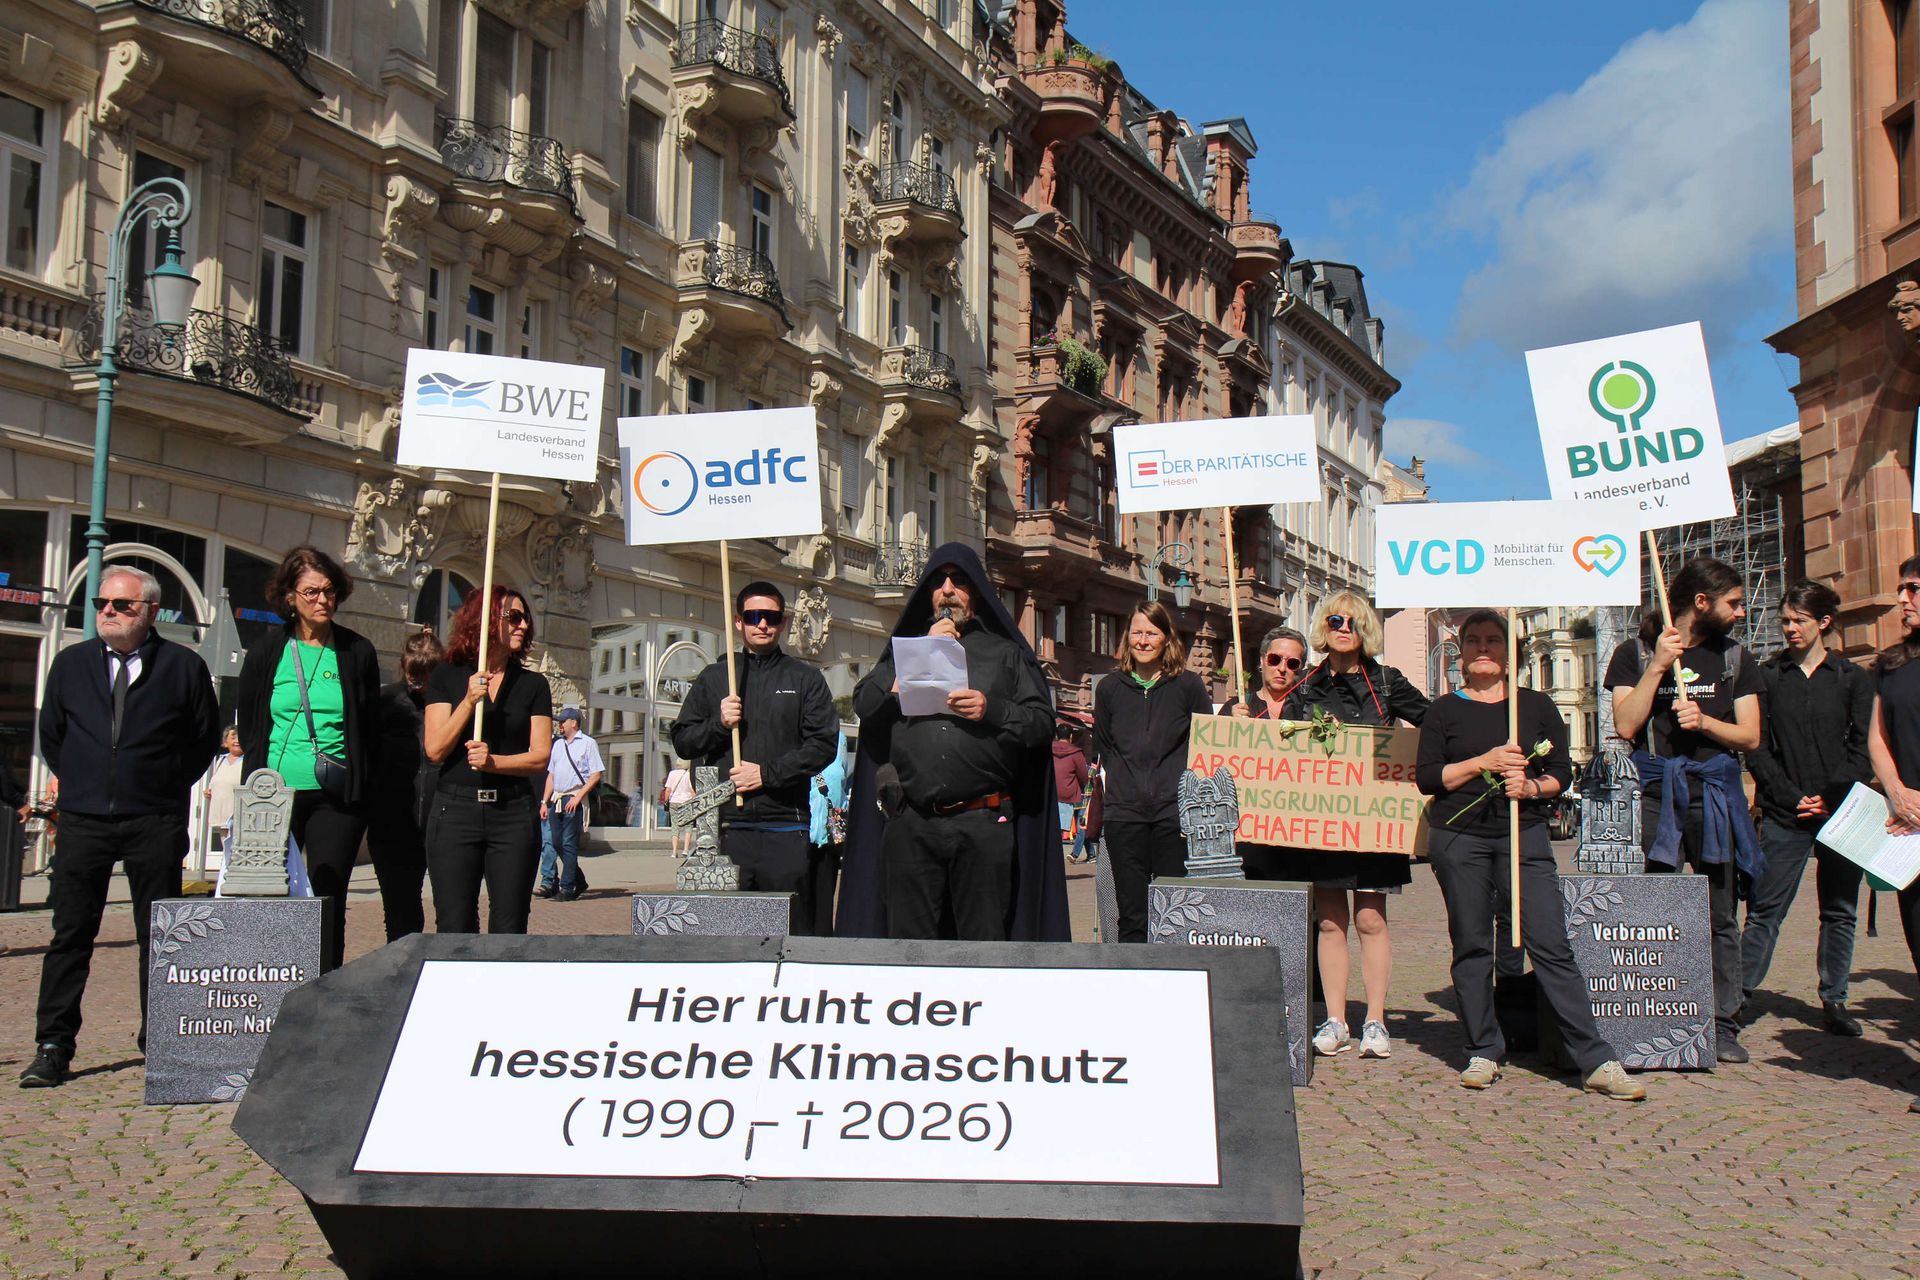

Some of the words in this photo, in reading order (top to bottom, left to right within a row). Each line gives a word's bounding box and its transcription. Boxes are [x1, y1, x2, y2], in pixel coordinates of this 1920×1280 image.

[499, 382, 590, 422] BWE
[497, 430, 586, 448] Landesverband
[541, 448, 585, 462] Hessen
[1566, 427, 1705, 478] BUND
[705, 448, 808, 488] adfc
[1162, 459, 1194, 475] DER
[1197, 453, 1308, 472] PARITÄTISCHE
[1163, 477, 1198, 487] Hessen
[708, 493, 752, 506] Hessen
[1387, 539, 1485, 576] VCD
[1494, 544, 1544, 555] Mobilität
[1547, 543, 1564, 554] für
[1494, 556, 1556, 567] Menschen.
[243, 811, 283, 832] RIP
[1595, 800, 1629, 824] RIP
[1196, 823, 1225, 840] RIP
[1235, 813, 1360, 848] CHAFFEN
[1375, 821, 1405, 849] !!!
[1188, 929, 1267, 947] Gestorben:
[1592, 922, 1681, 942] Verbrannt:
[1610, 948, 1664, 966] Wälder
[166, 963, 304, 987] Ausgetrocknet:
[1589, 973, 1618, 991] und
[1621, 973, 1677, 991] Wiesen
[207, 989, 263, 1012] Flüsse,
[627, 987, 745, 1023] Hier
[757, 989, 873, 1025] ruht
[886, 992, 983, 1027] der
[1591, 1000, 1622, 1017] ürre
[1626, 998, 1640, 1016] in
[1645, 998, 1698, 1016] Hessen
[178, 1015, 238, 1038] Ernten,
[244, 1014, 275, 1033] Nat
[470, 1041, 753, 1079] hessische
[769, 1043, 1128, 1084] Klimaschutz
[840, 1101, 1013, 1151] 2026)
